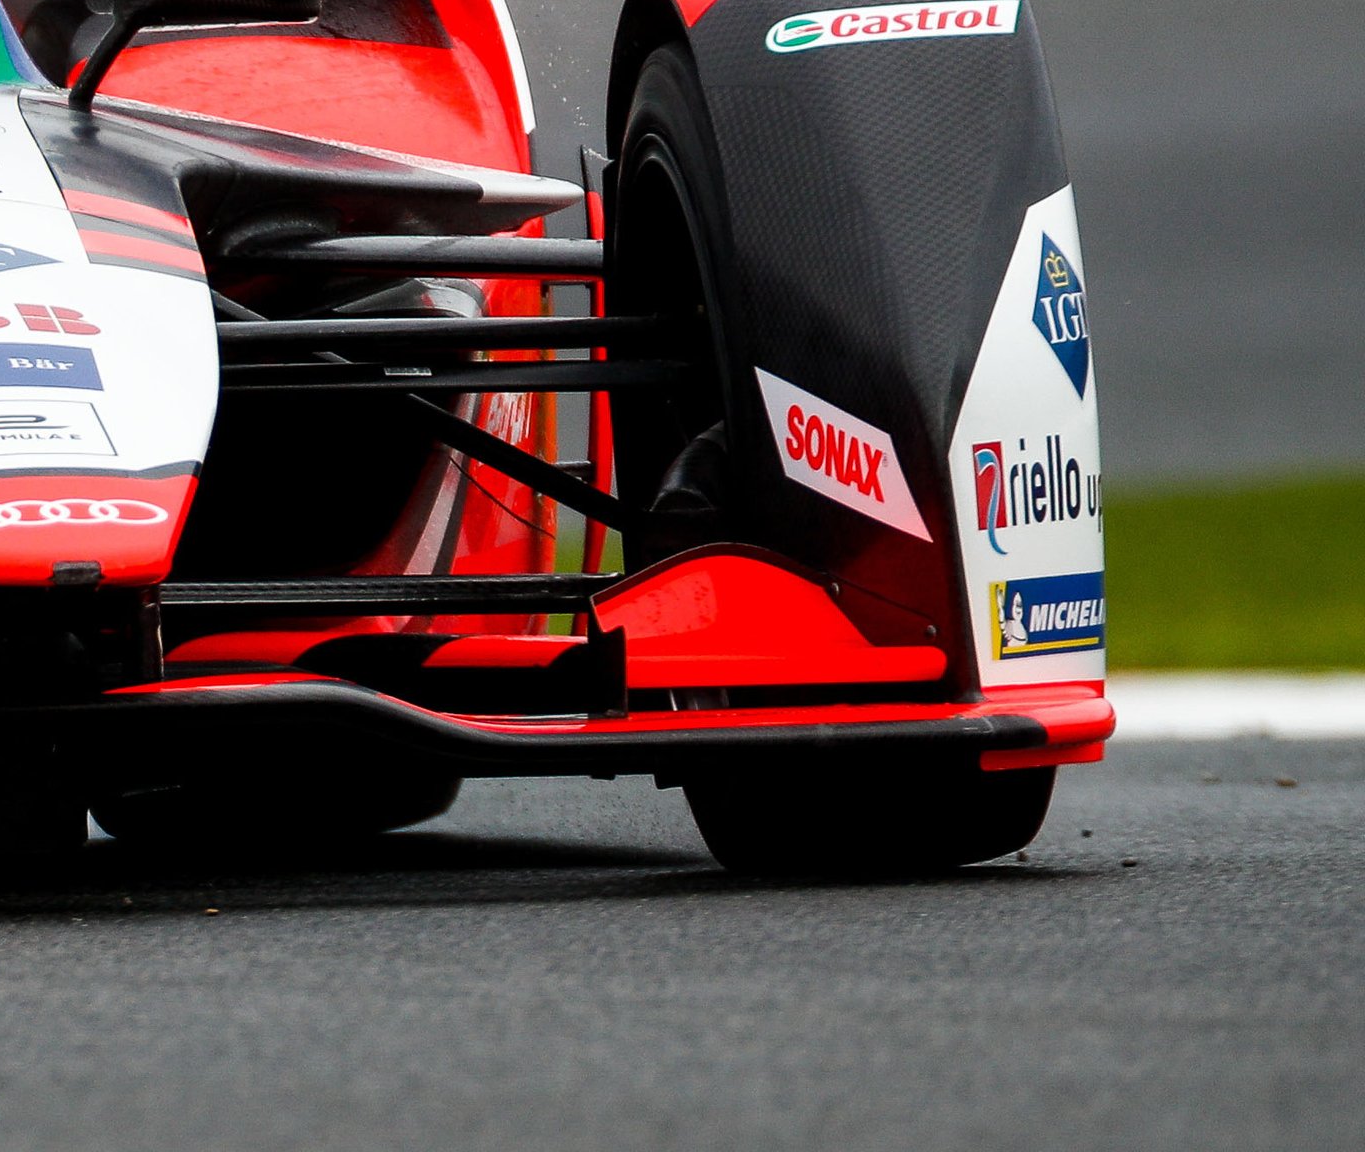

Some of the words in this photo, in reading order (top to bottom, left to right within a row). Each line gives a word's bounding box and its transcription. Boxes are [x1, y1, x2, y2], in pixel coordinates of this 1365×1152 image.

[831, 5, 1002, 37] Castrol
[9, 357, 74, 372] Bär
[69, 433, 82, 441] E
[786, 404, 884, 503] SONAX
[1010, 435, 1080, 526] riello
